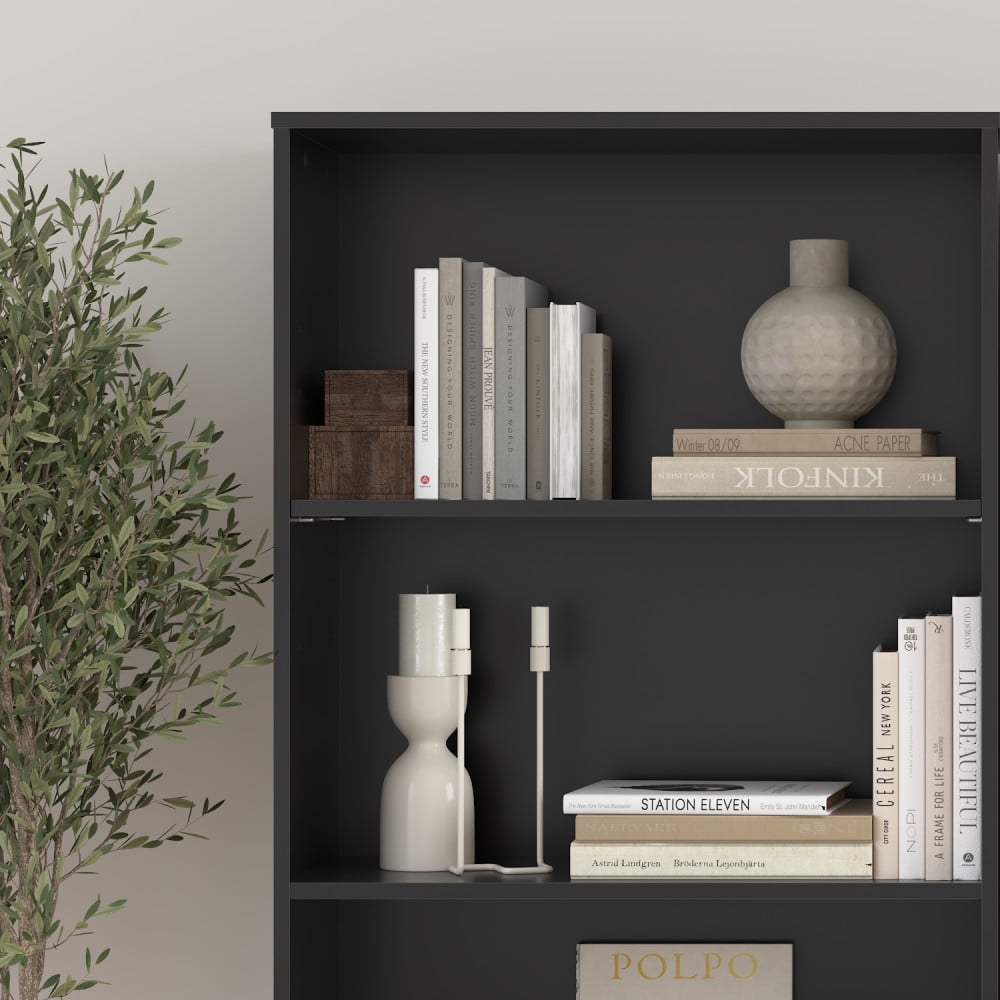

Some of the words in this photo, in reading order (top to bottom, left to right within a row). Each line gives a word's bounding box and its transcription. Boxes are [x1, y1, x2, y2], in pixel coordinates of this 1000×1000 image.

[421, 342, 429, 357] THE
[483, 346, 493, 370] JEAN
[421, 359, 429, 373] NEW
[421, 376, 429, 418] SOUTHERN
[483, 372, 495, 412] PROUVÉ
[421, 420, 429, 444] STYLE
[834, 434, 870, 451] ACNE
[876, 434, 911, 451] PAPER
[676, 438, 706, 452] Winter
[707, 438, 741, 452] 08/09
[732, 466, 885, 488] KINFOLK
[918, 472, 944, 482] THE
[881, 682, 891, 710] YORK
[958, 668, 977, 714] LIVE
[881, 713, 891, 736] NEW
[876, 744, 895, 807] CEREAL
[933, 766, 944, 787] LIFE
[958, 719, 977, 835] BEAUTIFUL
[640, 797, 696, 811] STATION
[700, 798, 751, 812] ELEVEN
[933, 791, 944, 809] FOR
[905, 808, 917, 854] NOPI
[933, 814, 944, 847] FRAME
[592, 859, 619, 868] Astrid
[621, 859, 661, 870] Lindgren
[933, 852, 944, 860] A
[610, 951, 759, 980] POLPO
